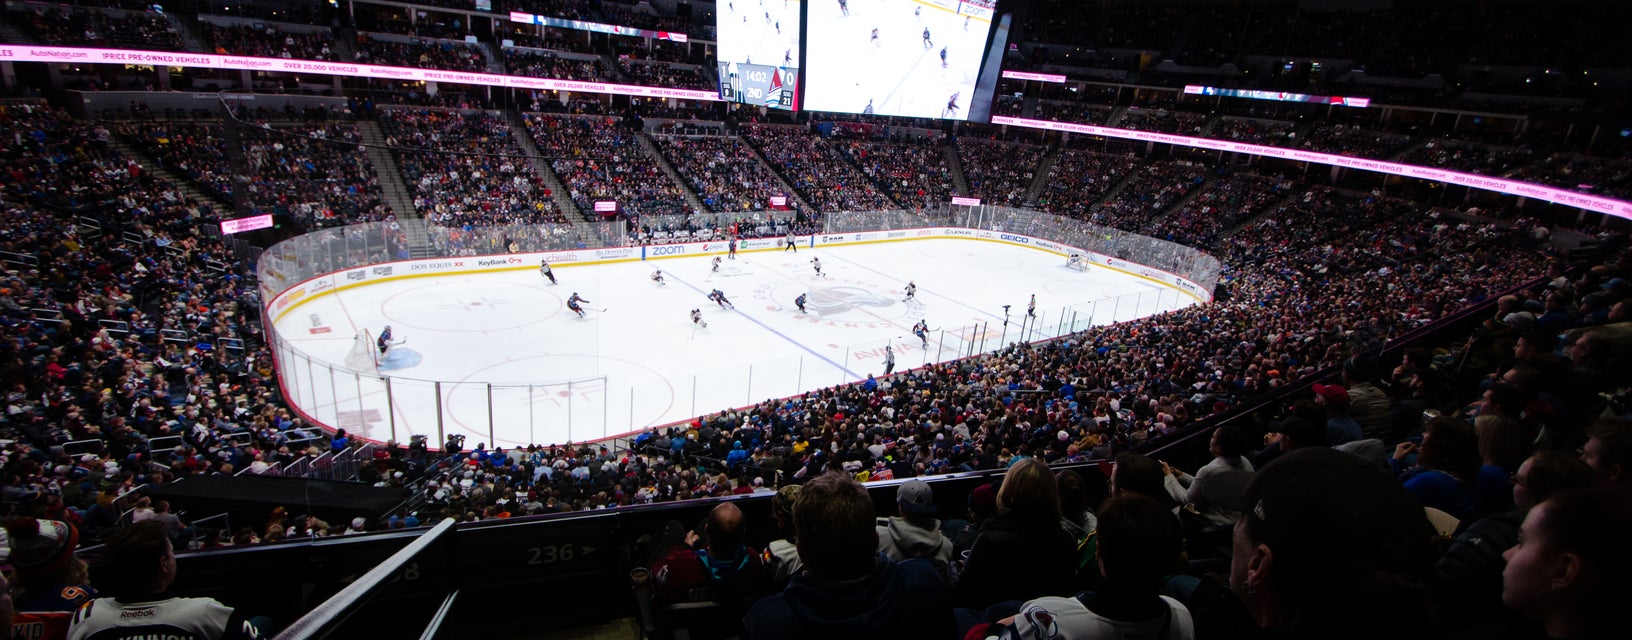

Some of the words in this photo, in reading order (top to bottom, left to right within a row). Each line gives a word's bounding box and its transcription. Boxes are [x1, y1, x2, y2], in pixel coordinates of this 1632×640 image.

[30, 50, 88, 59] AutoNation.com
[128, 54, 173, 62] PRE-OWNED
[175, 56, 210, 64] VEHICLES
[224, 59, 272, 67] AutoNation.com
[303, 63, 326, 71] 20,000
[328, 65, 358, 73] VEHICLES
[721, 65, 726, 78] 1
[745, 70, 767, 83] 14:02
[443, 73, 474, 81] PRE-OWNED
[476, 75, 501, 83] VEHICLES
[786, 72, 794, 86] 0
[724, 88, 729, 96] 9
[746, 86, 763, 99] 2ND
[782, 97, 791, 105] 21
[1379, 163, 1403, 172] VEHICLES
[1482, 180, 1507, 189] VEHICLES
[1000, 233, 1029, 243] GEICO
[652, 245, 684, 255] zoom
[478, 258, 507, 266] KeyBank
[528, 544, 574, 565] 236
[120, 609, 155, 618] Reebok
